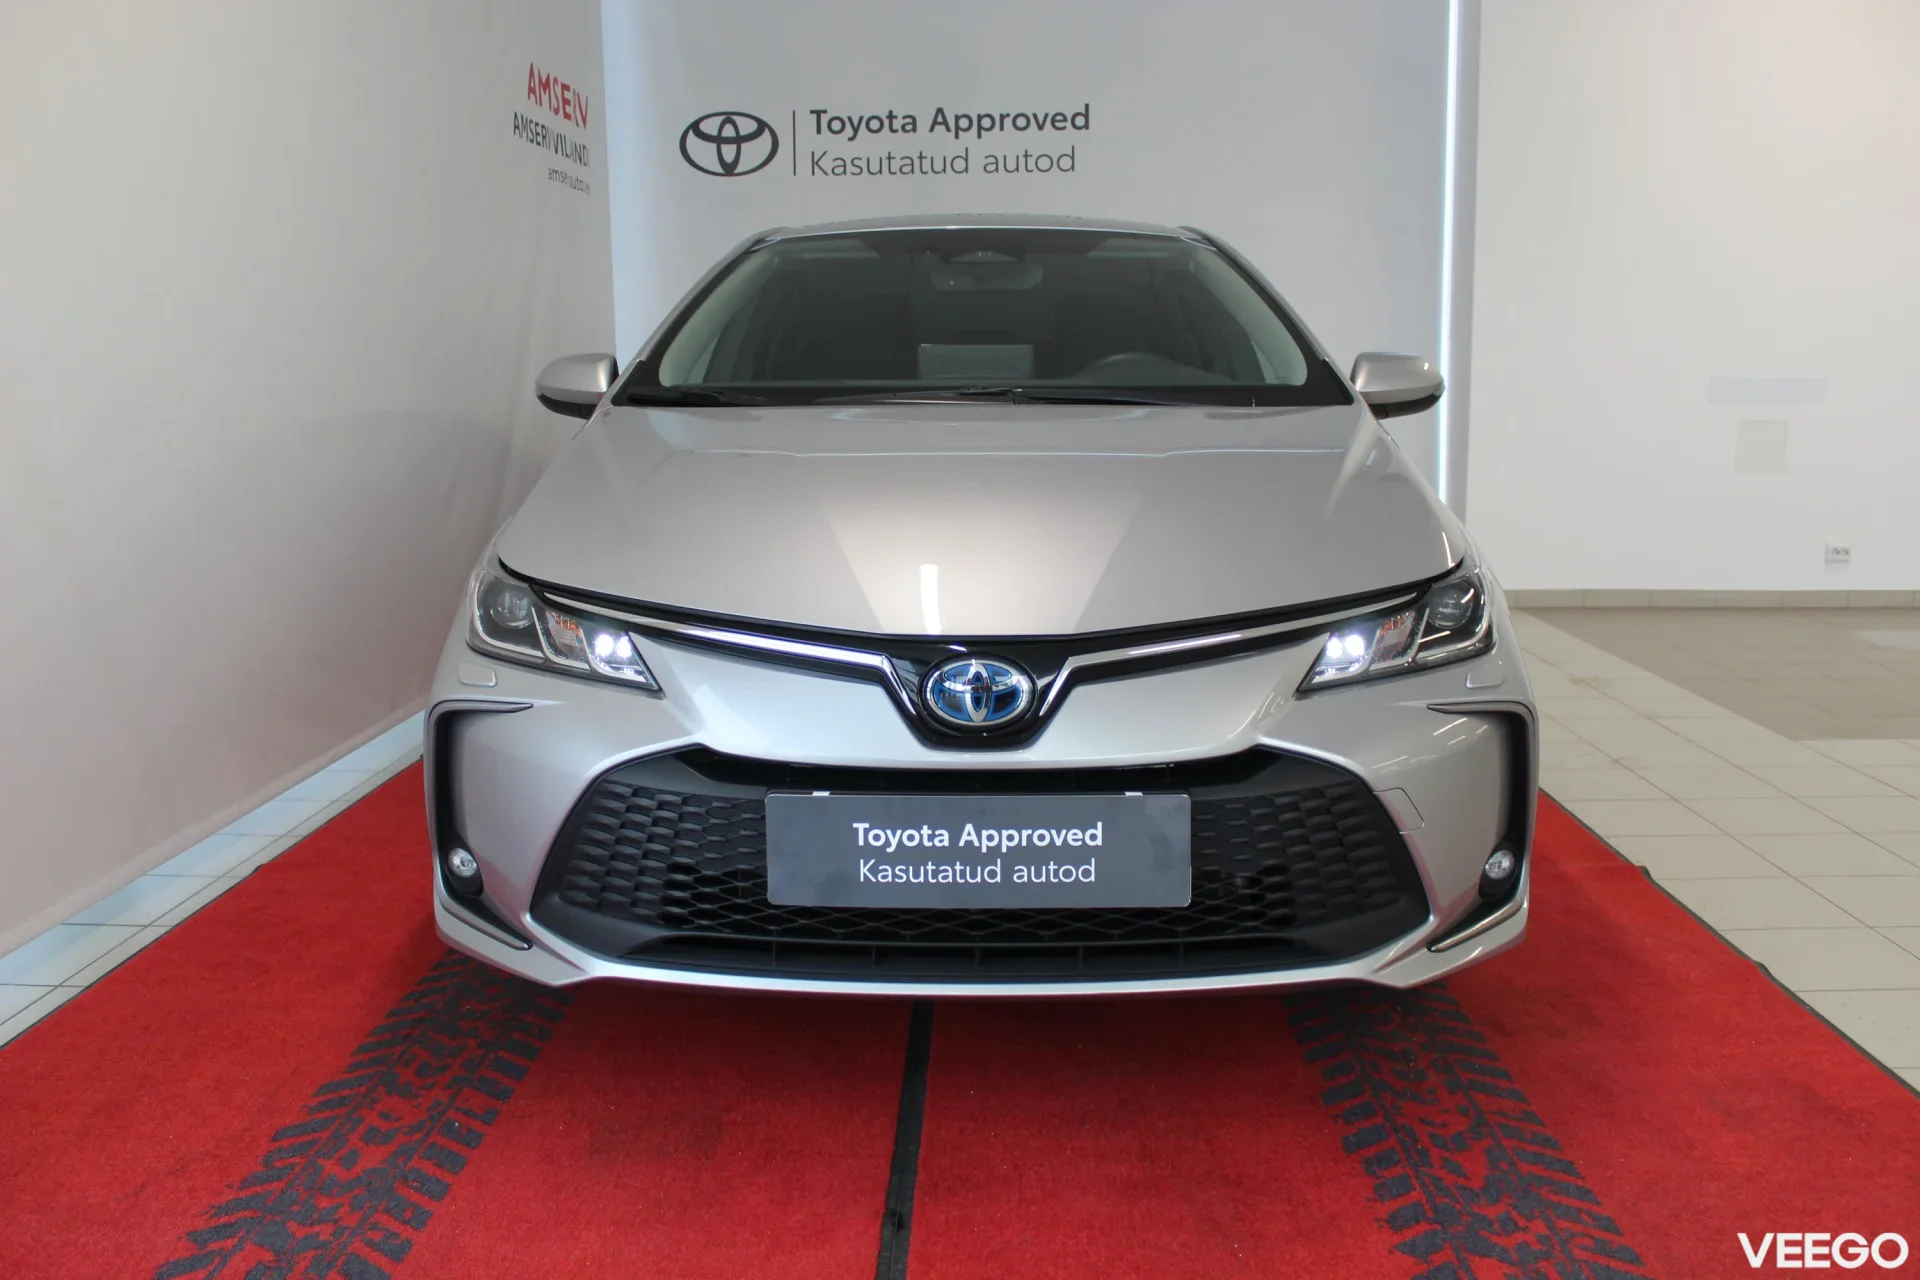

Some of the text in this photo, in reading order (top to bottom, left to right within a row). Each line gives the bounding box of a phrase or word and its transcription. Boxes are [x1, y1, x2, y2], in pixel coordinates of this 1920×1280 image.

[809, 103, 1090, 142] Toyota Approved
[810, 145, 1076, 176] Kasutatud autod
[852, 821, 1103, 853] Toyota Approved
[859, 858, 1096, 883] Kasutatud autod
